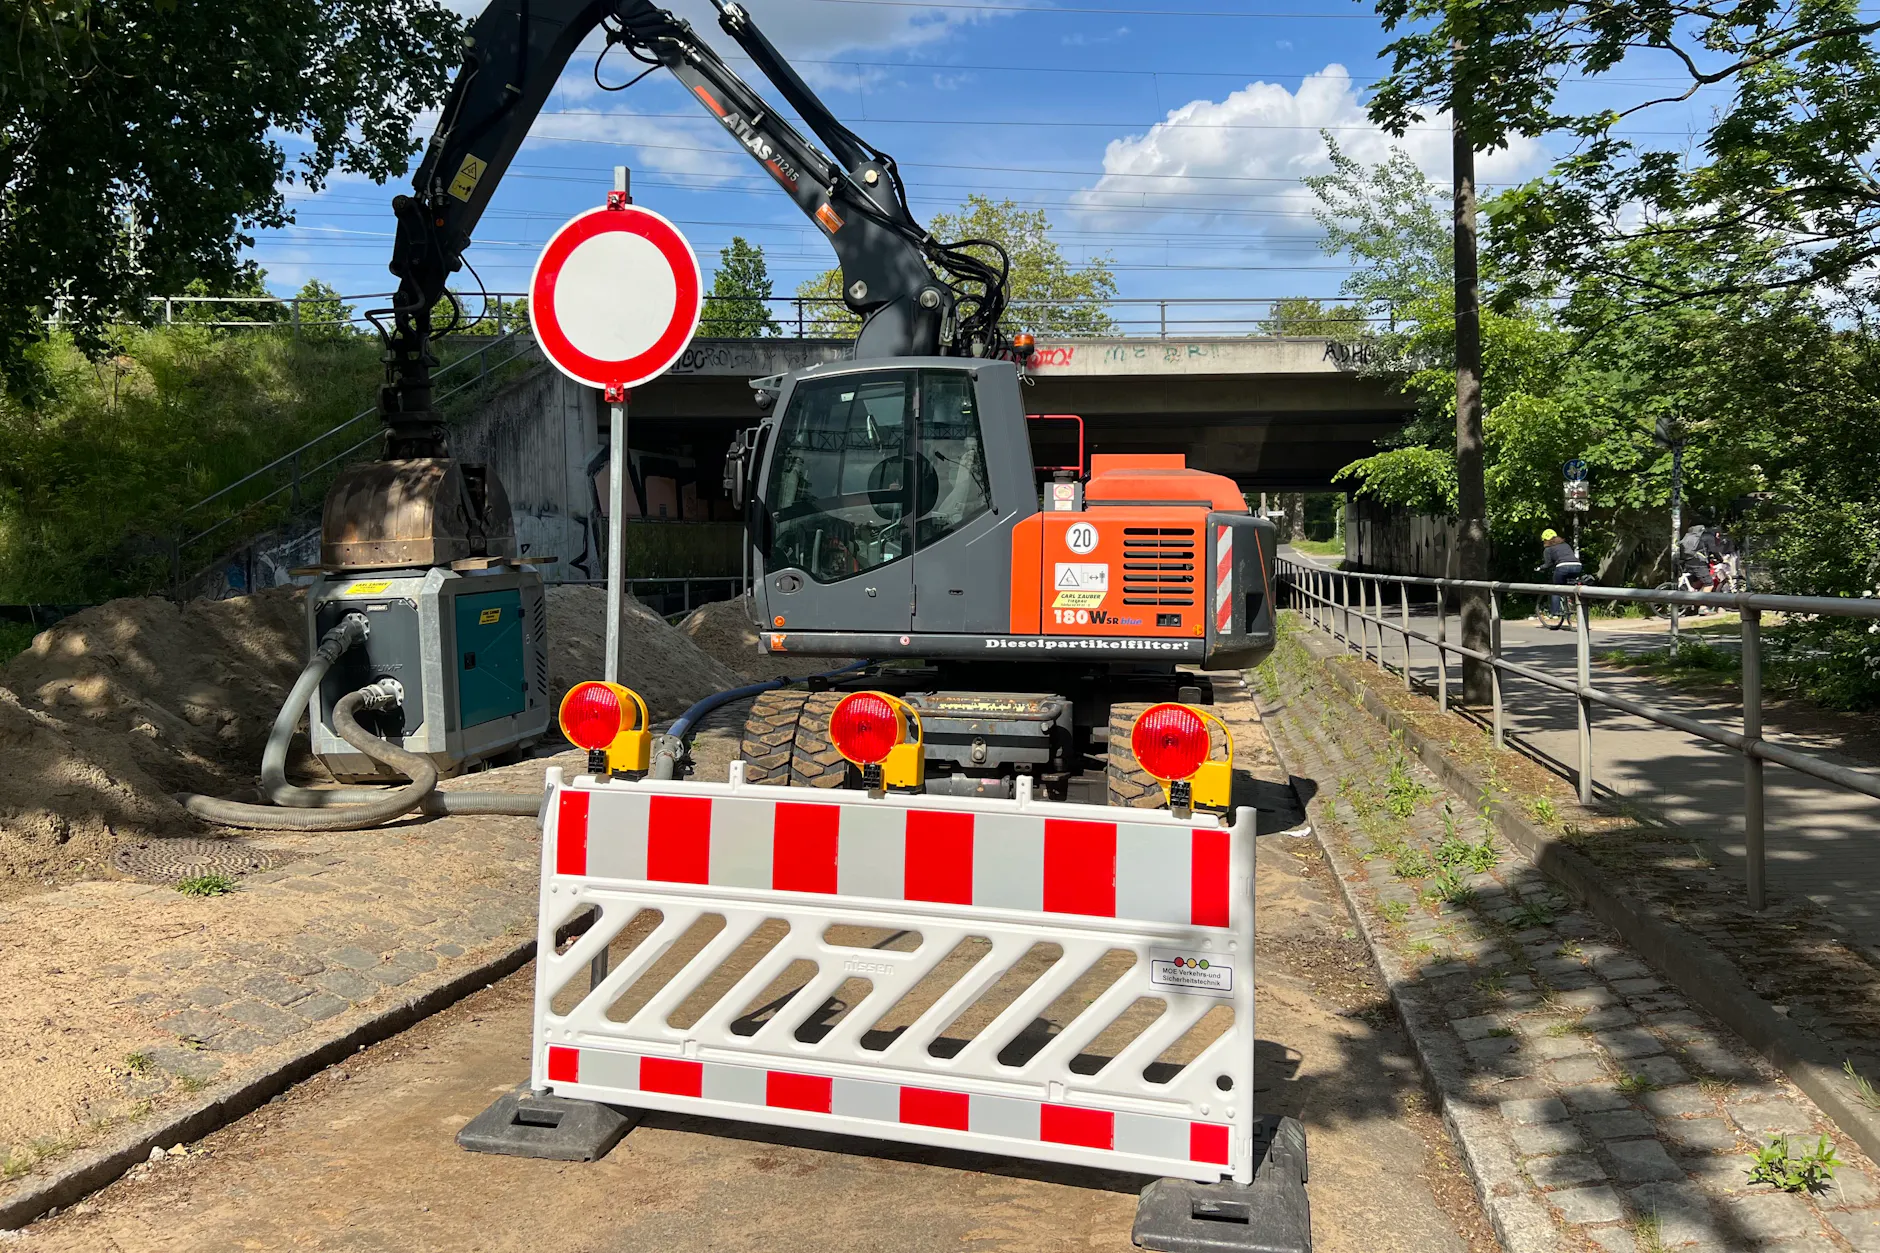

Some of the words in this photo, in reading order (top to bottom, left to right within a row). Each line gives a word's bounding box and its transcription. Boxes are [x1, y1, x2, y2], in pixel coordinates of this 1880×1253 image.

[722, 112, 773, 160] ATLAS
[1073, 528, 1091, 548] 20
[1120, 617, 1142, 625] blue
[985, 639, 1189, 651] Dieselpartikelfilter!
[843, 954, 895, 975] nissen
[1162, 967, 1178, 975] MOE
[1179, 969, 1221, 979] Verkehrs-und
[1162, 975, 1221, 987] Sicherheitstechnik
